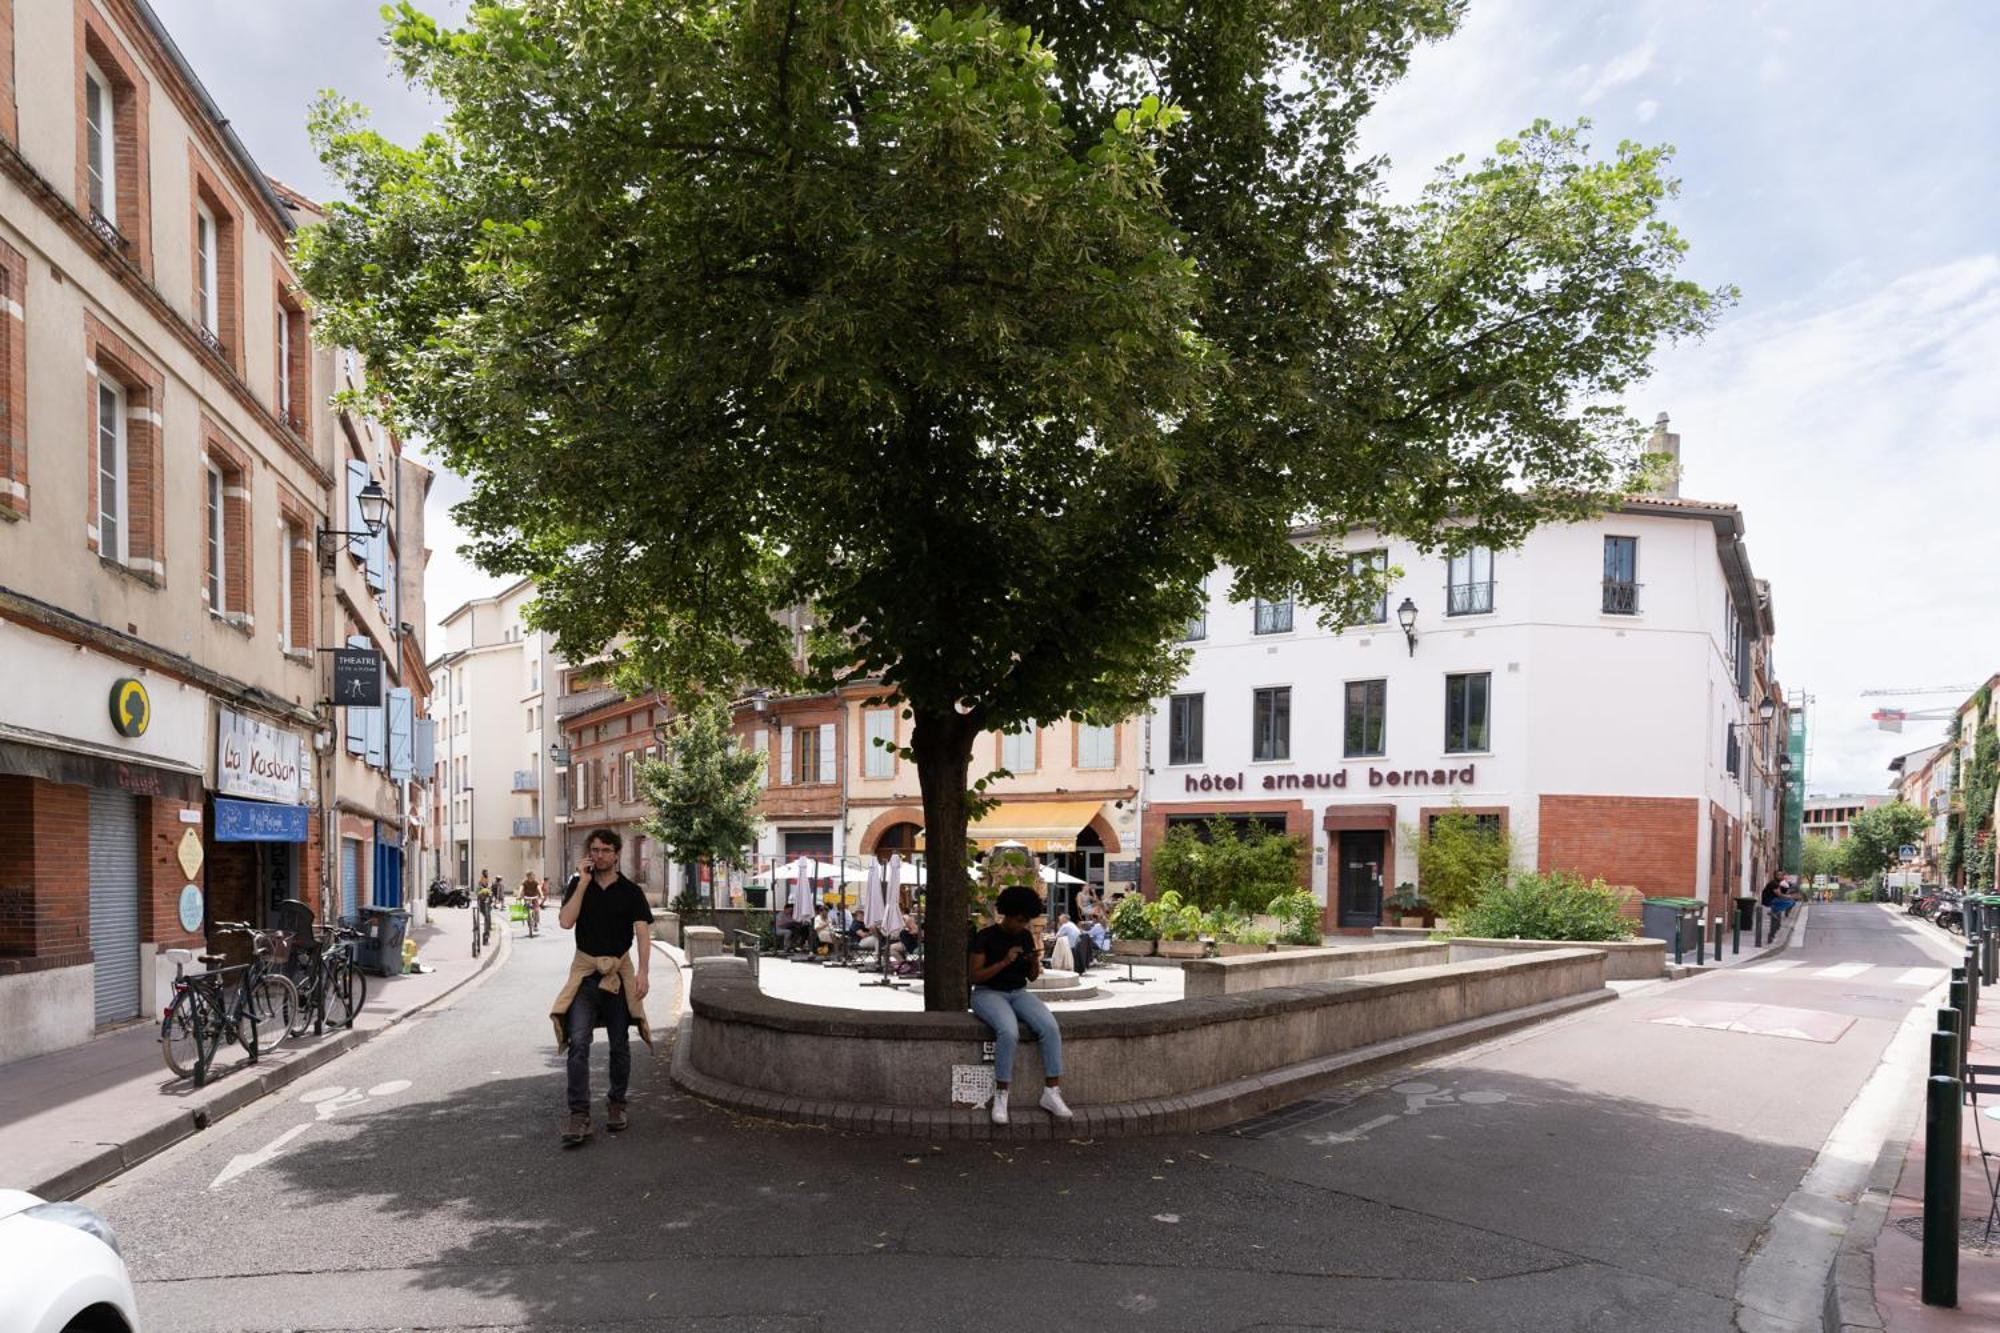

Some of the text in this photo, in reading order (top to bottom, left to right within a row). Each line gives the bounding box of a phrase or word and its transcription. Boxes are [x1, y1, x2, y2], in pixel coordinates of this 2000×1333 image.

[225, 738, 241, 770] La
[1185, 763, 1475, 793] hôtel arnaud bernard
